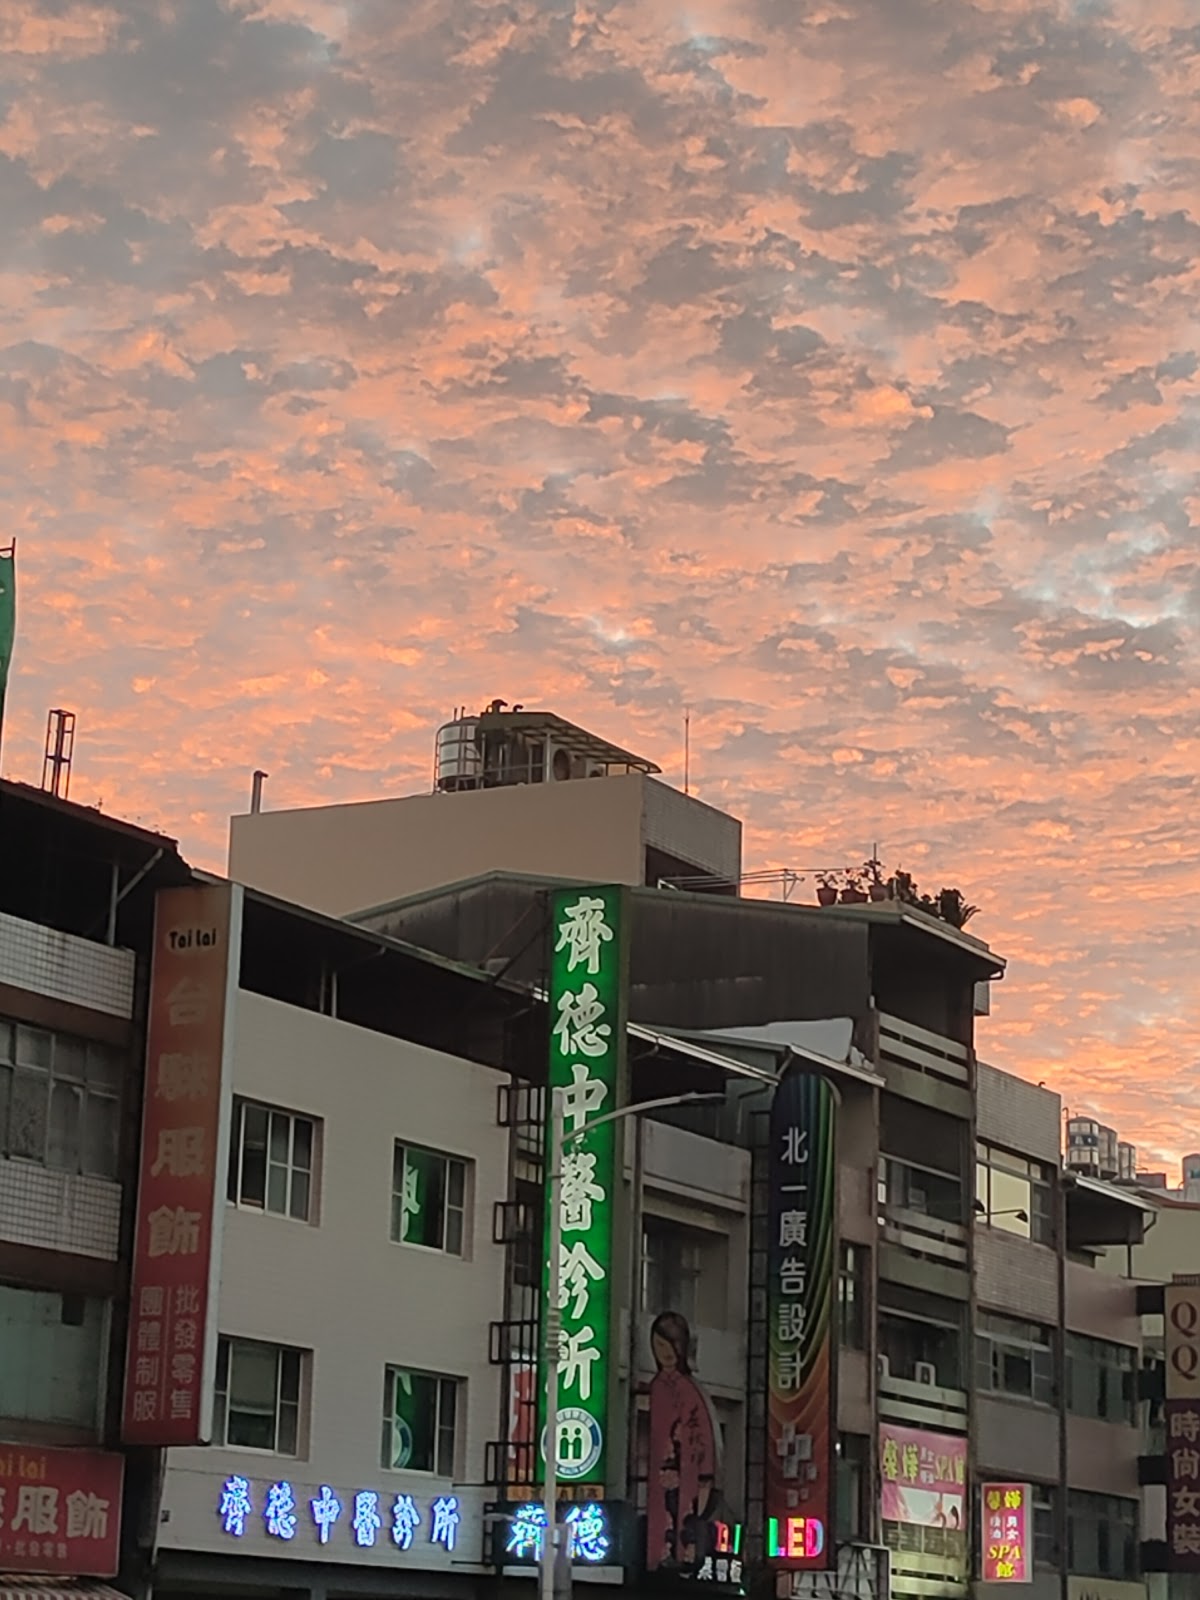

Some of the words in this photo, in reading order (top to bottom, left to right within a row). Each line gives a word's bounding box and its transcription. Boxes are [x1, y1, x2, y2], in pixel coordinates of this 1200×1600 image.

[168, 928, 192, 949] Tai
[545, 897, 613, 1400] 齊德中醫診所
[778, 1126, 809, 1389] 北一廣告設計
[133, 1286, 163, 1421] 團體制服
[170, 1284, 199, 1419] 批發零售
[0, 1485, 110, 1539] 服飾
[220, 1475, 460, 1551] 齊德中醫診所
[1170, 1409, 1200, 1555] 時尚女裝
[506, 1504, 609, 1561] 齊德
[768, 1517, 824, 1557] LED
[988, 1545, 1021, 1560] SPA
